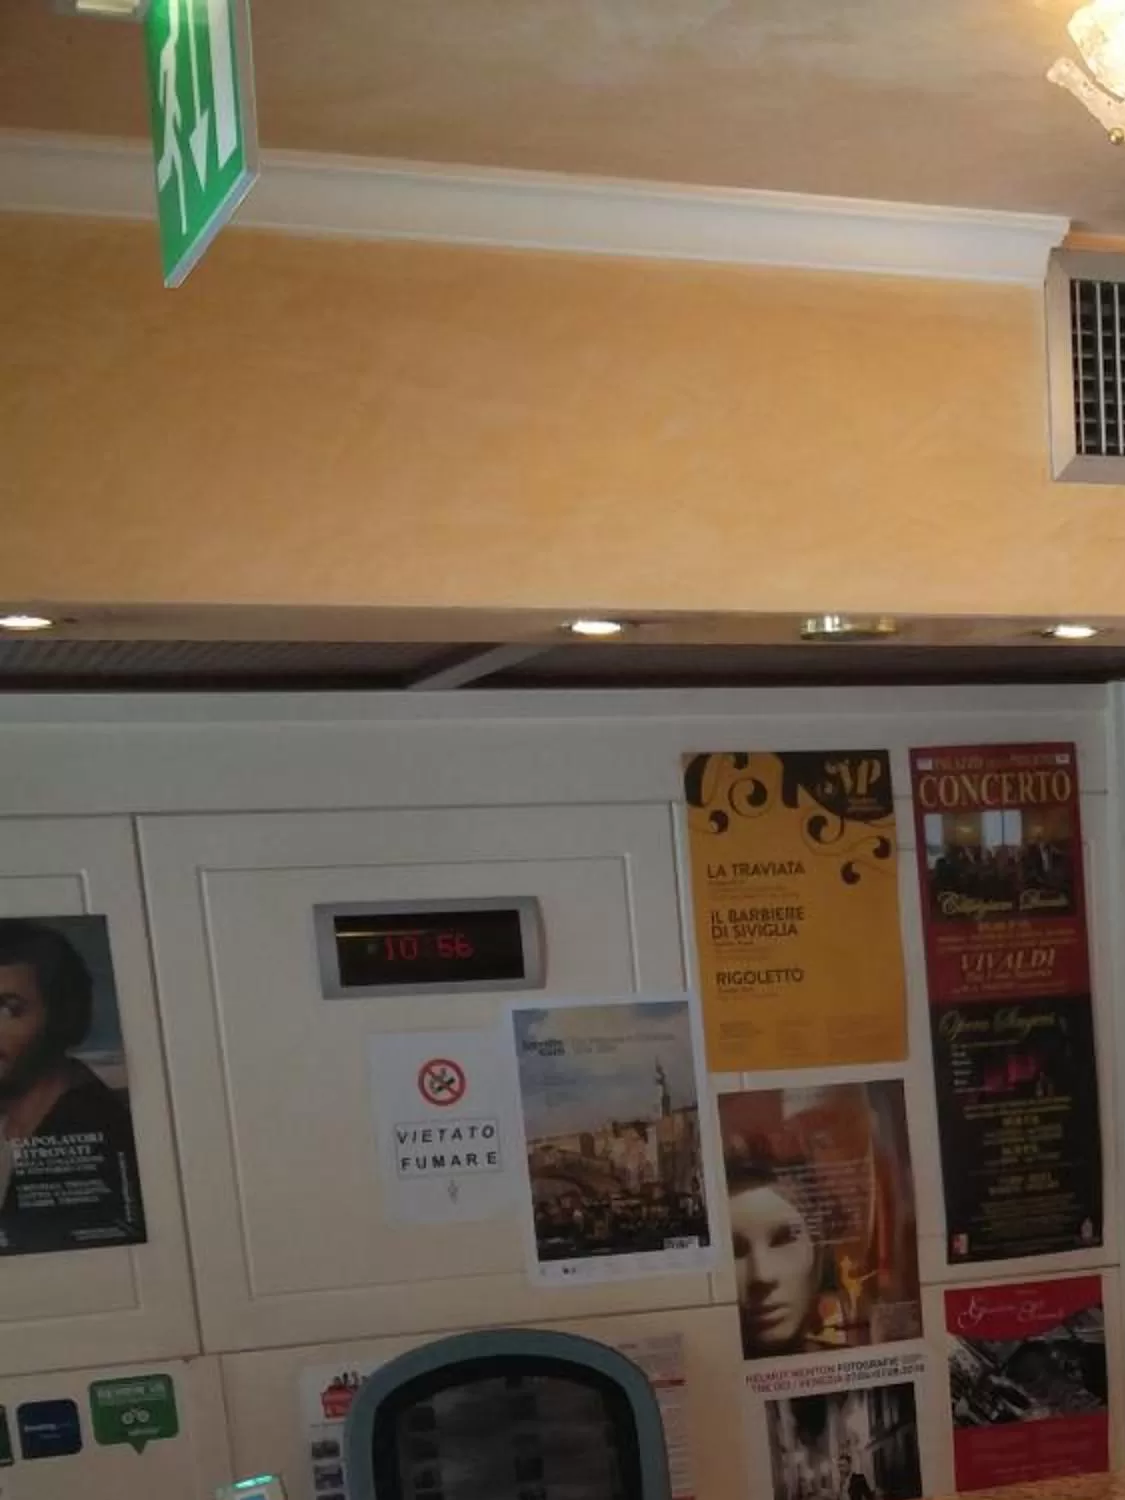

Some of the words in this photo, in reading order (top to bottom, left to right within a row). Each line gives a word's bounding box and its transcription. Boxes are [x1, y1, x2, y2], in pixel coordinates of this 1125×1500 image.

[918, 769, 1072, 808] CONCERTO
[706, 863, 728, 879] LA
[730, 860, 806, 877] TRAVIATA
[711, 910, 725, 925] IL
[727, 906, 805, 924] BARBIERE
[711, 924, 729, 940] DI
[732, 921, 799, 940] SIVIGLIA
[961, 947, 1057, 973] VIVALDI
[715, 967, 805, 986] RIGOLETTO
[396, 1123, 496, 1145] VIETATO
[399, 1151, 498, 1172] FUMARE
